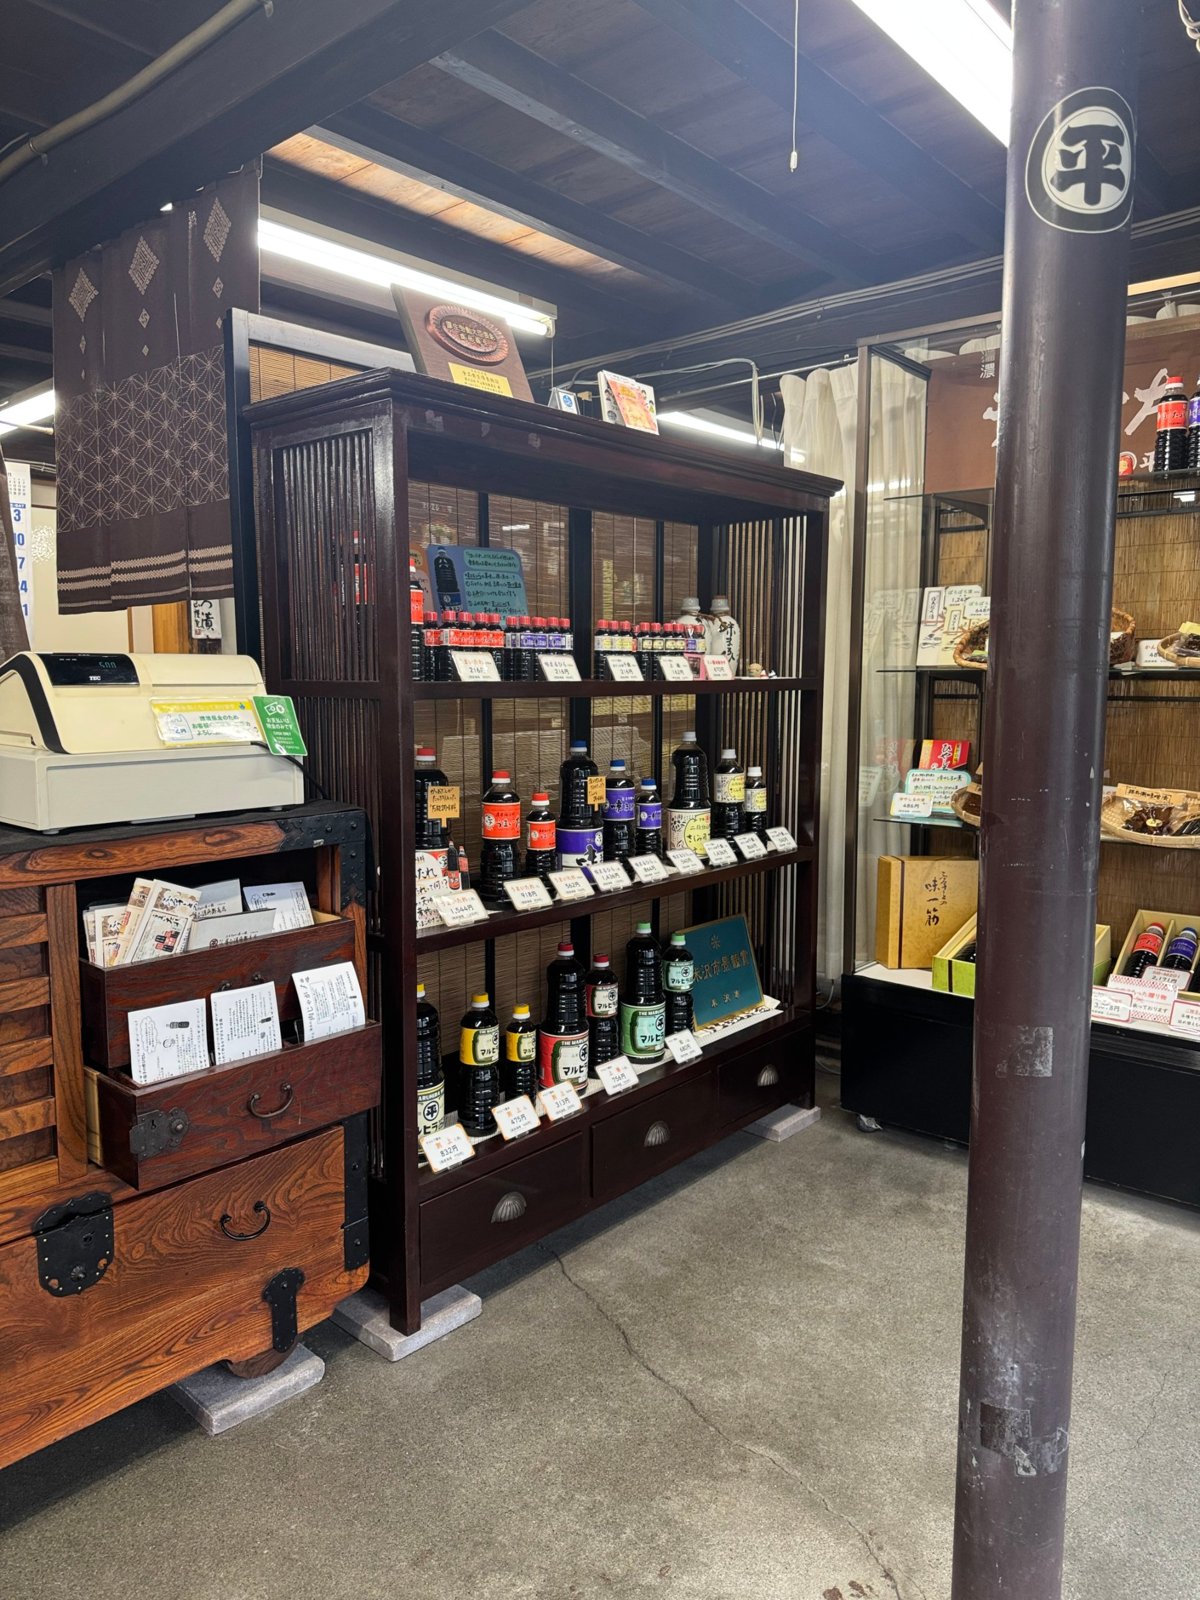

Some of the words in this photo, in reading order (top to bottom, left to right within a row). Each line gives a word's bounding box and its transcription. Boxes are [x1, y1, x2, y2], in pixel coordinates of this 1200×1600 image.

[1047, 118, 1128, 209] 平
[14, 509, 21, 522] 3
[439, 1144, 460, 1157] 832円
